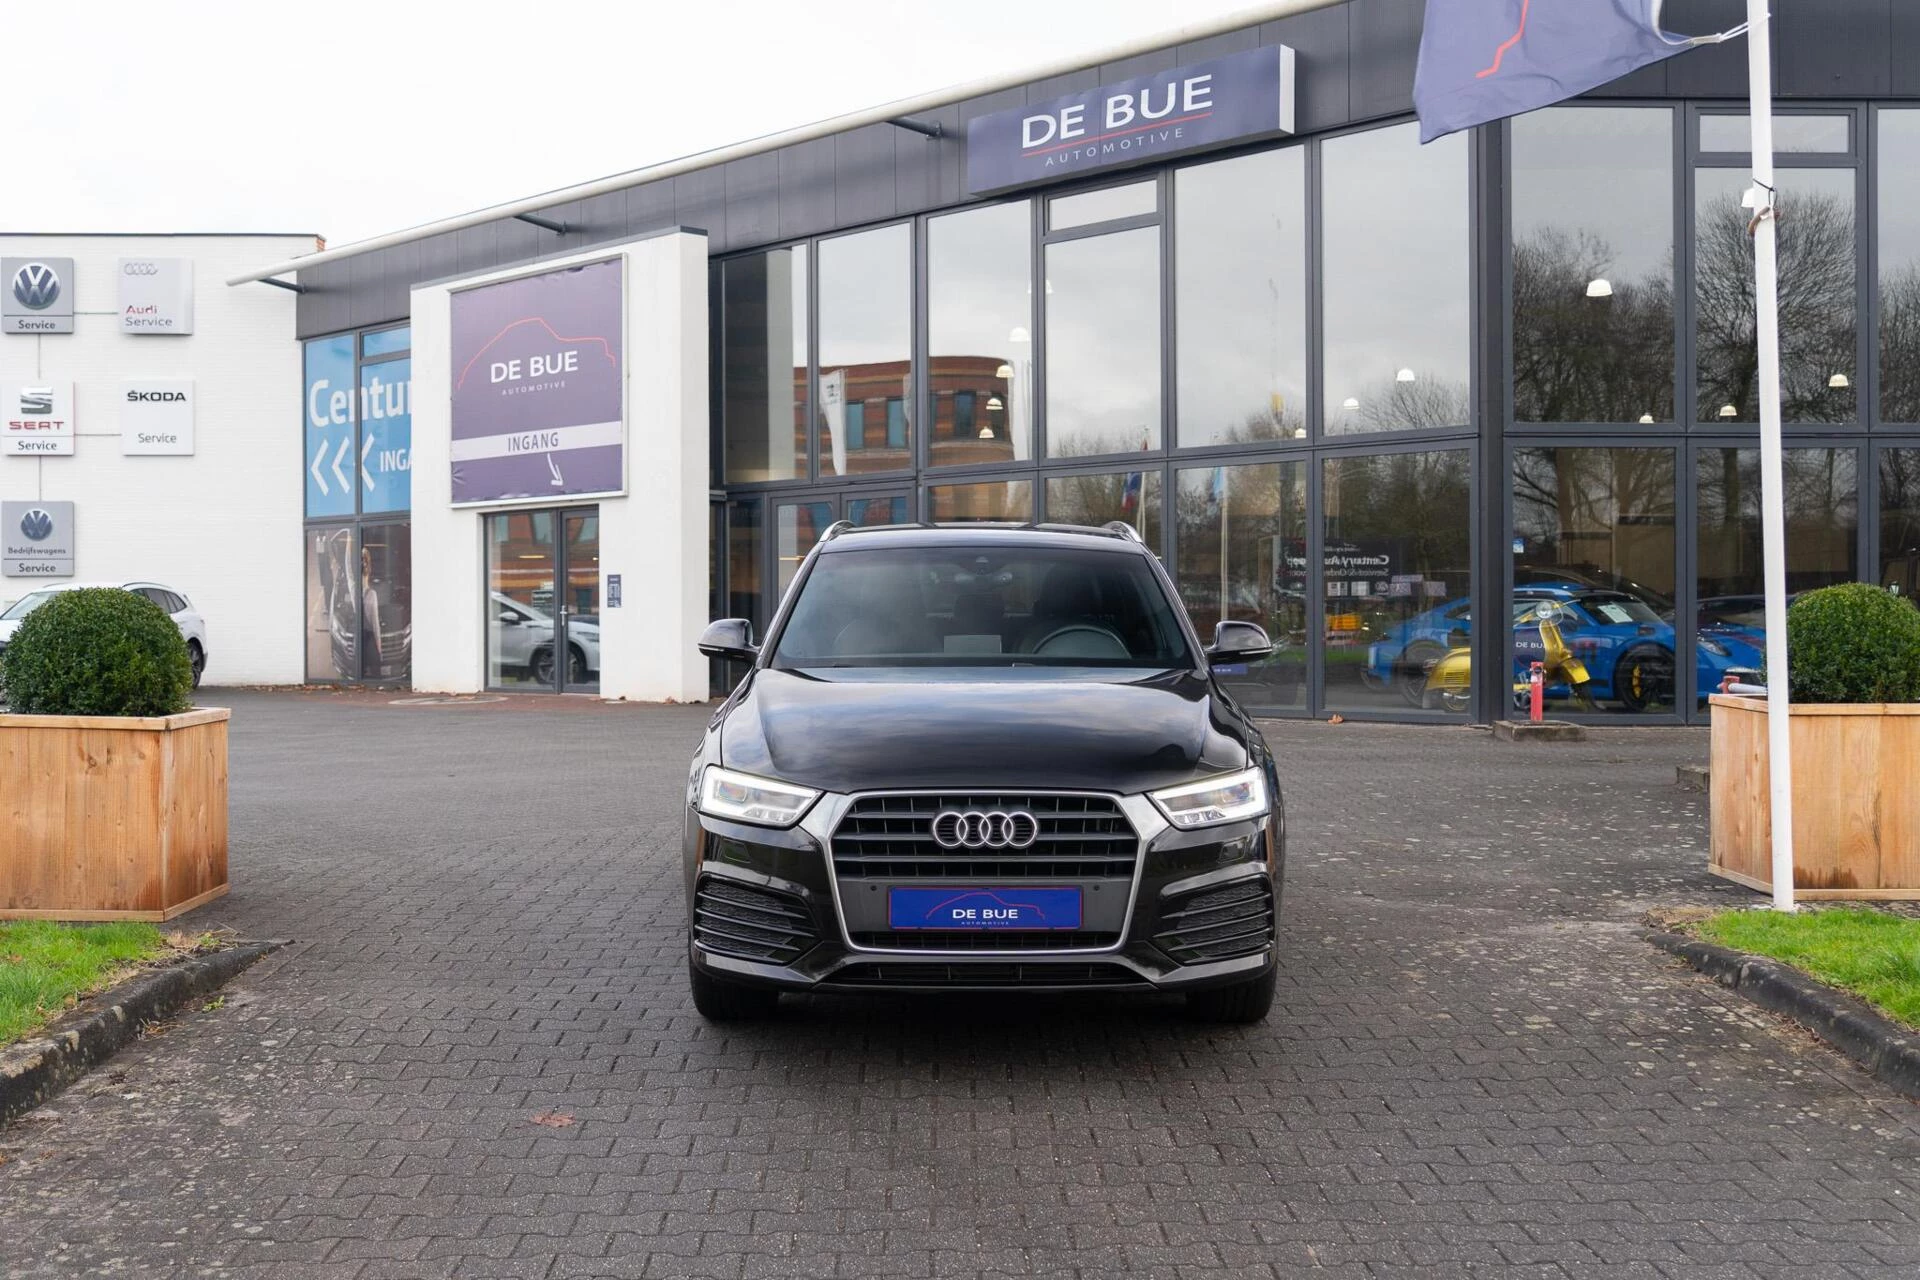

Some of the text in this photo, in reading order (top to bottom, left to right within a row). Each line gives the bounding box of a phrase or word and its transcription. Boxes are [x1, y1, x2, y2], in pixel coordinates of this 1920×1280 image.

[1022, 74, 1213, 149] DE BUE
[1045, 128, 1184, 167] AUTOMOTIVE
[126, 305, 158, 314] Audi
[18, 319, 56, 330] Service
[125, 317, 173, 327] Service
[490, 351, 579, 383] DE BUE
[501, 381, 566, 395] AUTOMOTIVE
[127, 390, 187, 402] ŠKODA
[9, 421, 64, 430] SEAT
[138, 433, 177, 443] Service
[507, 432, 559, 452] INGANG
[18, 441, 57, 451] Service
[8, 547, 66, 556] Bedrijfswagens
[18, 563, 56, 573] Service
[953, 909, 1018, 919] DE BUE
